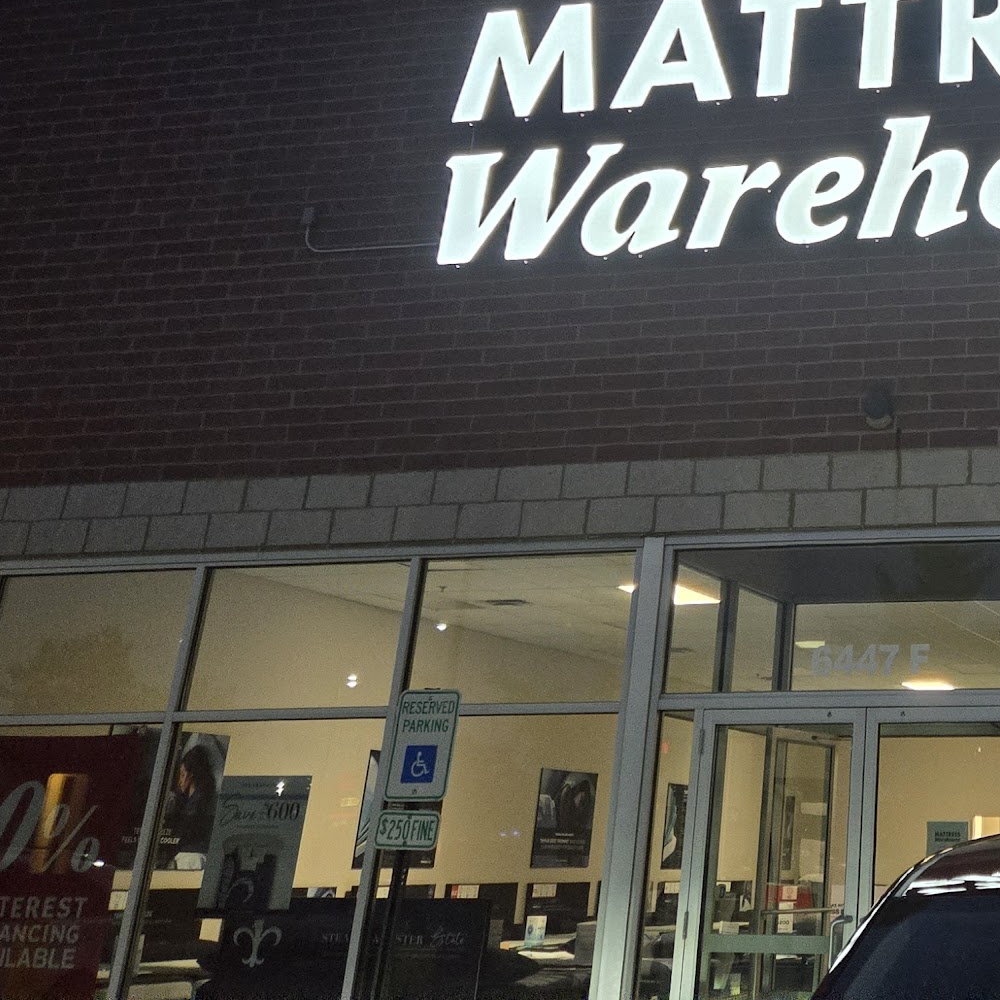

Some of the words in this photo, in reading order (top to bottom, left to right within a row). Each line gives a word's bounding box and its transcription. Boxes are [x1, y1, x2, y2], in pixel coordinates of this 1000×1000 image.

[811, 643, 899, 676] 6447
[910, 643, 930, 675] F
[402, 701, 455, 715] RESERVED
[402, 719, 449, 733] PARKING
[380, 818, 411, 841] $250
[410, 819, 435, 841] FINE
[0, 924, 80, 945] ANCING
